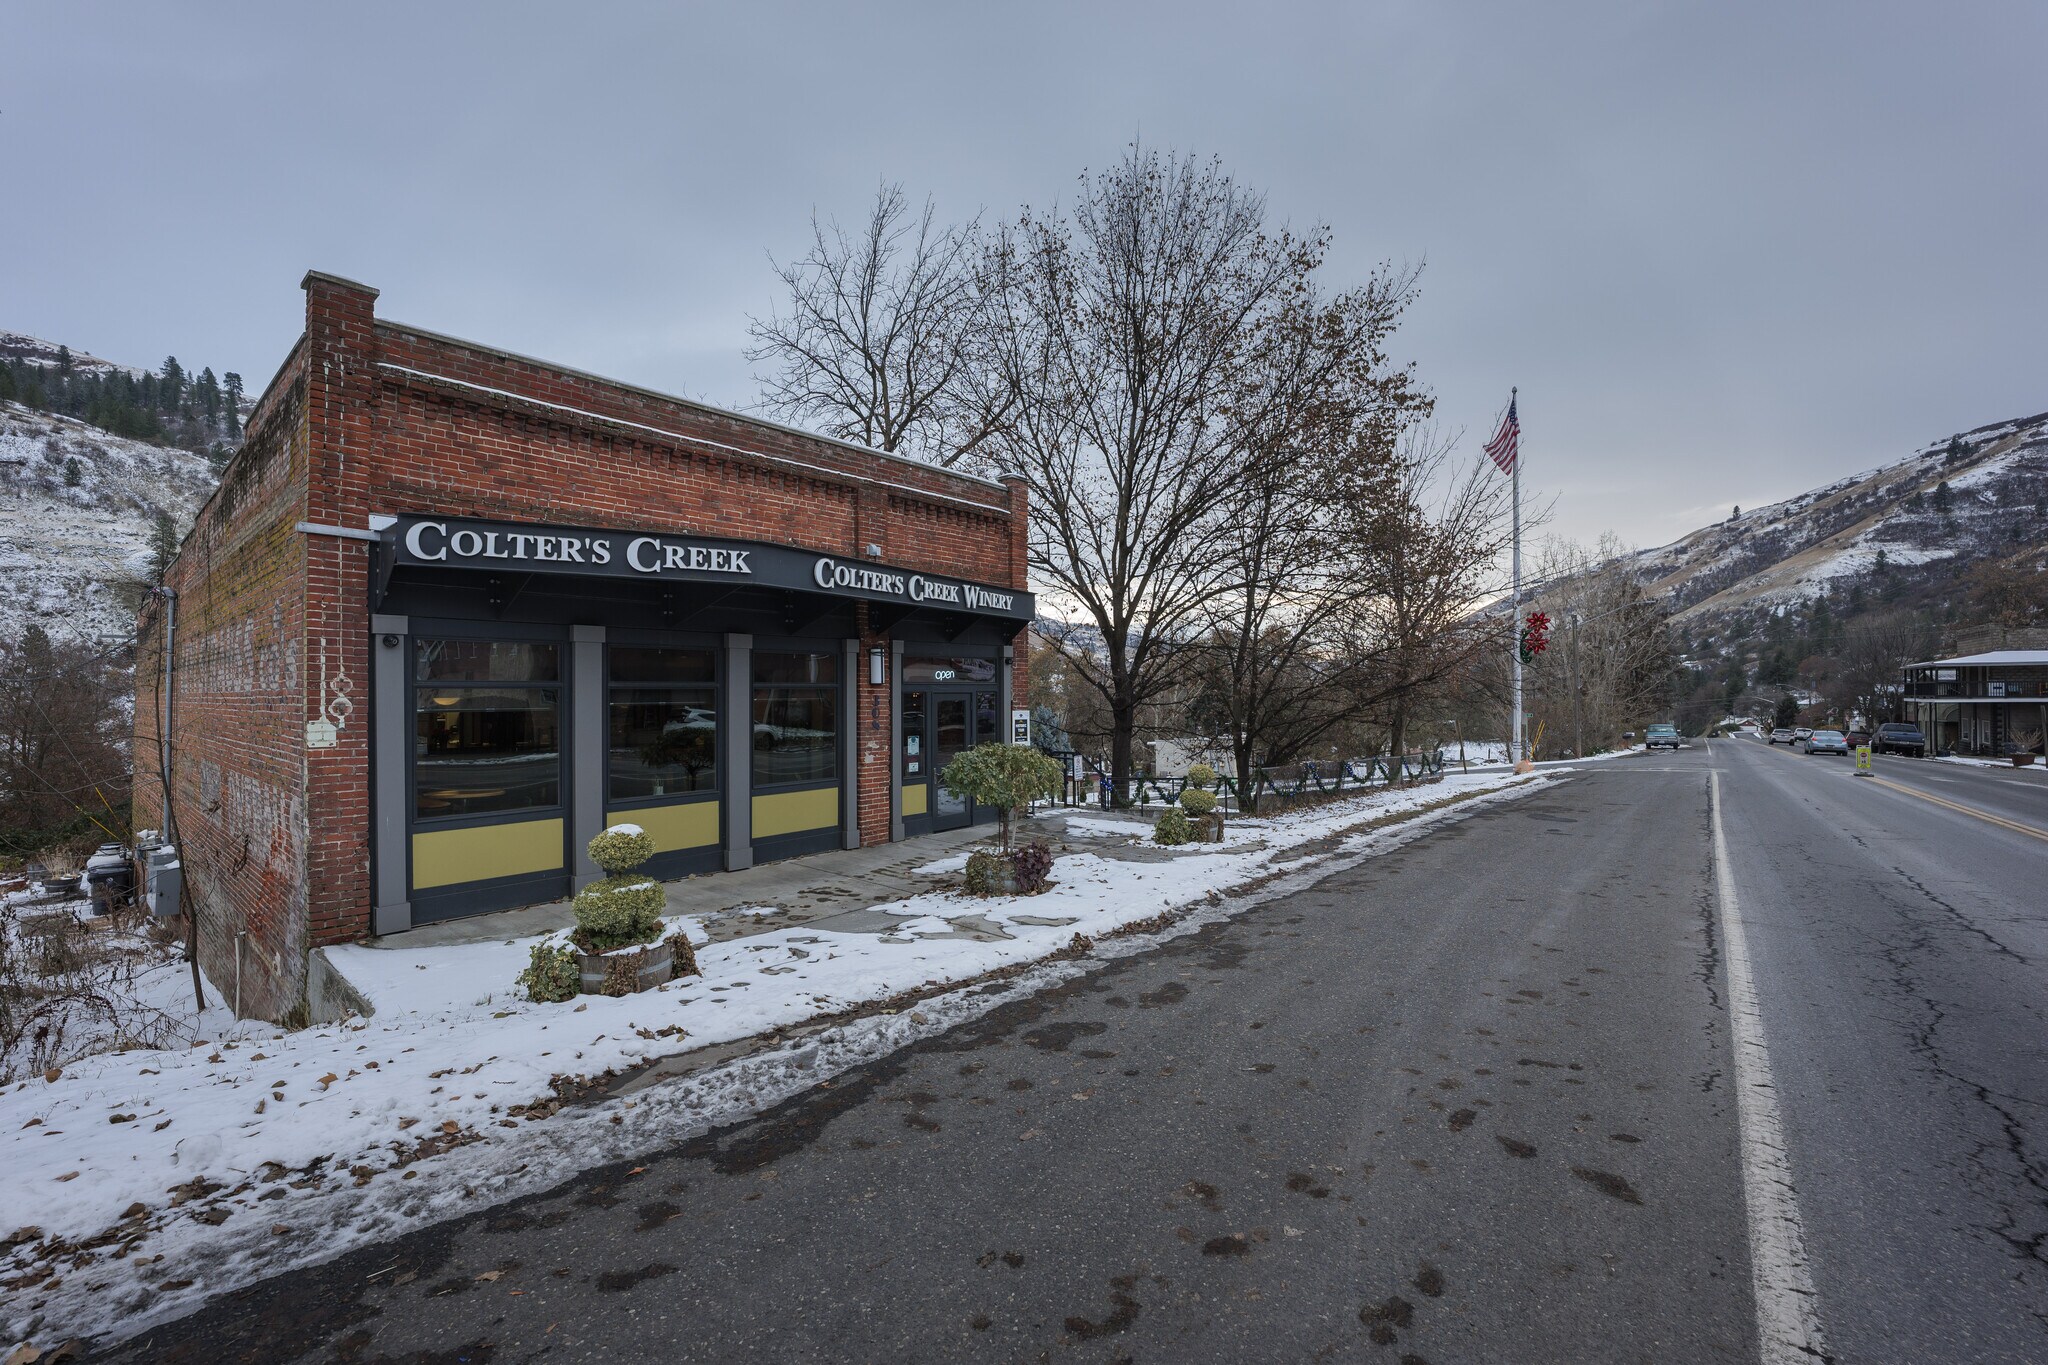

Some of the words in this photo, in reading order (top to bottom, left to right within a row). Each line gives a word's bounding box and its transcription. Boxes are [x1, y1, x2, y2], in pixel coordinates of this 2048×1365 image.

[405, 521, 611, 564] COLTER'S
[626, 537, 752, 574] CREEK
[813, 557, 904, 595] COLTER'S
[908, 574, 959, 603] CREEK
[962, 584, 1013, 611] WINERY
[935, 670, 955, 681] open
